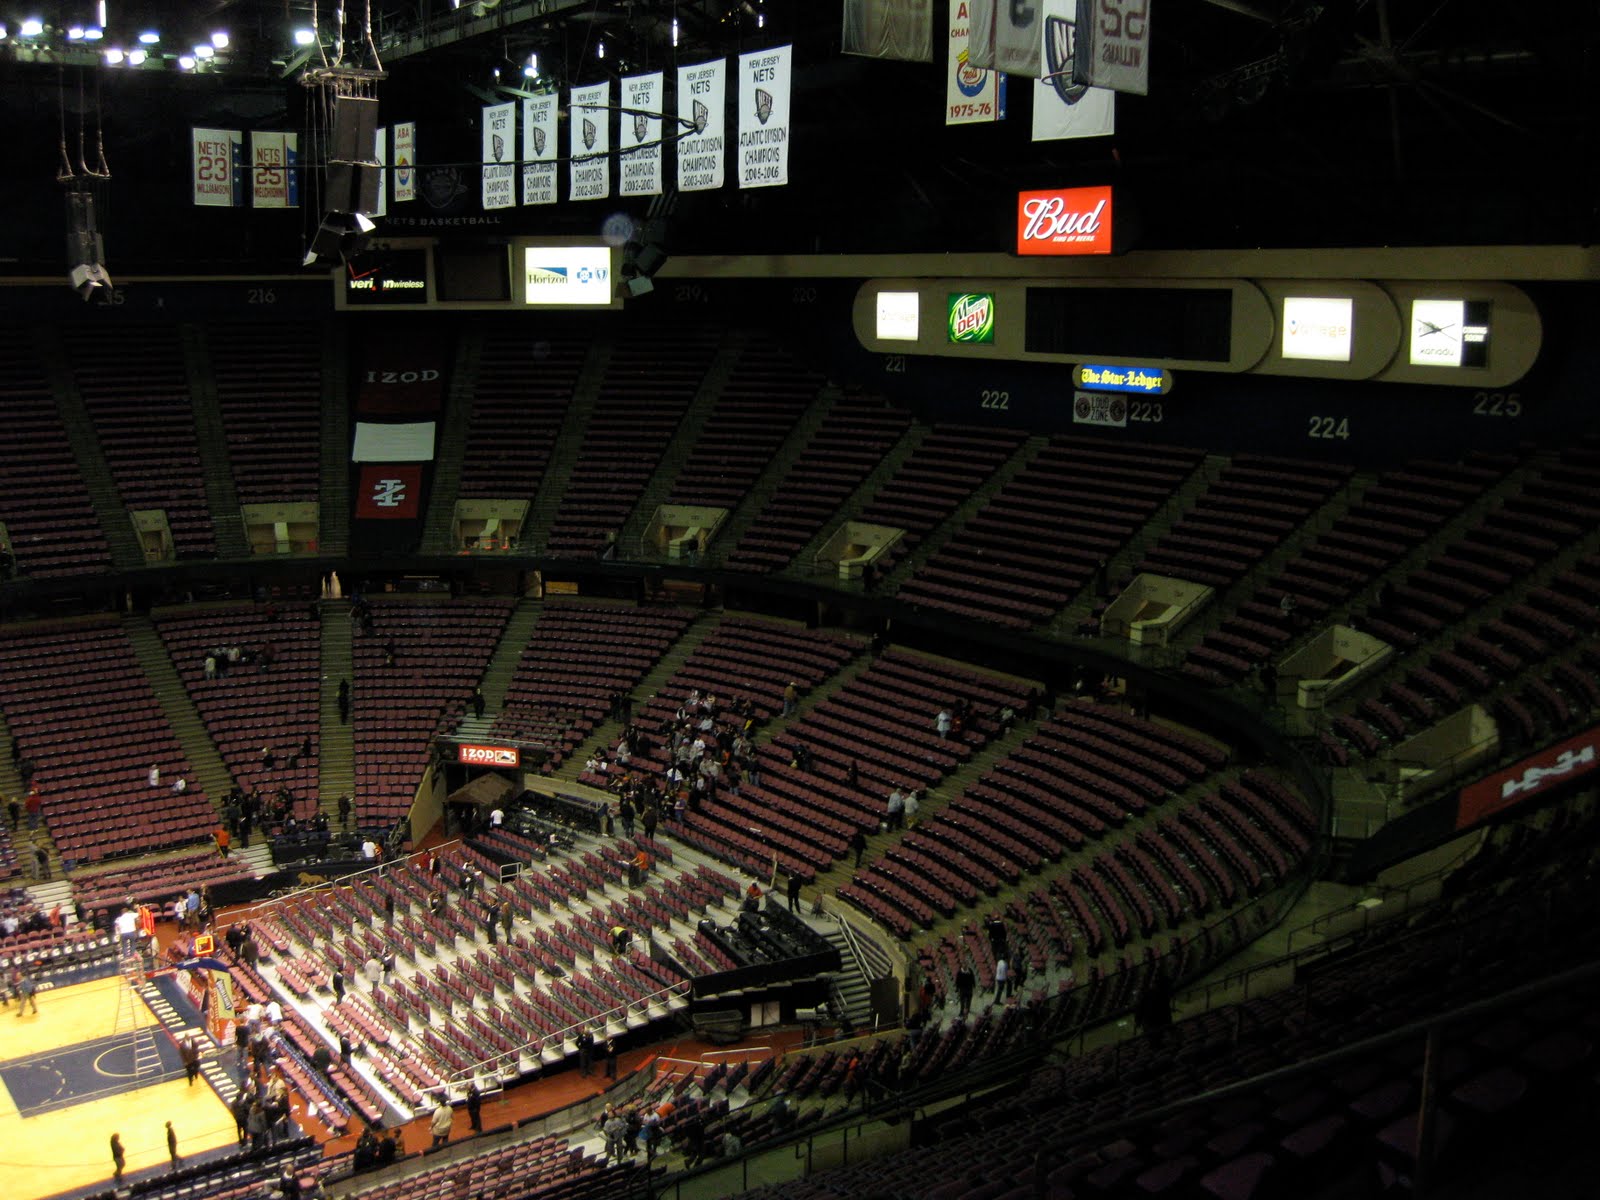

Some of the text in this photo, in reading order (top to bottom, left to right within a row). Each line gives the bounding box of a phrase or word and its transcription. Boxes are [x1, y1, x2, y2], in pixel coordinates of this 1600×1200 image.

[749, 55, 781, 69] NEW JERSEY
[687, 68, 716, 81] NEW JERSEY
[753, 67, 775, 83] NETS
[629, 81, 654, 93] NEW JERSEY
[690, 80, 711, 95] NETS
[632, 92, 650, 105] NETS
[532, 111, 548, 123] NETS
[949, 102, 992, 118] 1975-76
[492, 118, 506, 131] NETS
[397, 127, 410, 139] ABA
[740, 129, 764, 146] ATLANTIC
[198, 141, 227, 157] NETS
[256, 148, 280, 162] NETS
[745, 147, 780, 166] CHAMPIONS
[198, 156, 228, 182] 23
[624, 161, 655, 178] CHAMPIONS
[682, 155, 717, 172] CHAMPIONS
[256, 163, 282, 185] 25
[575, 168, 603, 183] CHAMPIONS
[419, 215, 502, 227] BASKETBALL
[1023, 197, 1107, 240] Bud
[394, 279, 425, 290] wireless
[528, 274, 569, 285] Horizon
[248, 288, 277, 304] 216
[885, 355, 906, 373] 221
[366, 369, 440, 384] IZOD
[1080, 368, 1163, 390] The Star-Ledger
[981, 390, 1009, 411] 222
[1091, 396, 1110, 409] LOUD
[1473, 391, 1522, 417] 225
[1091, 409, 1109, 422] ZONE
[1130, 401, 1163, 423] 223
[1308, 415, 1351, 440] 224
[462, 748, 495, 759] IZOD
[150, 998, 187, 1029] JERSEY
